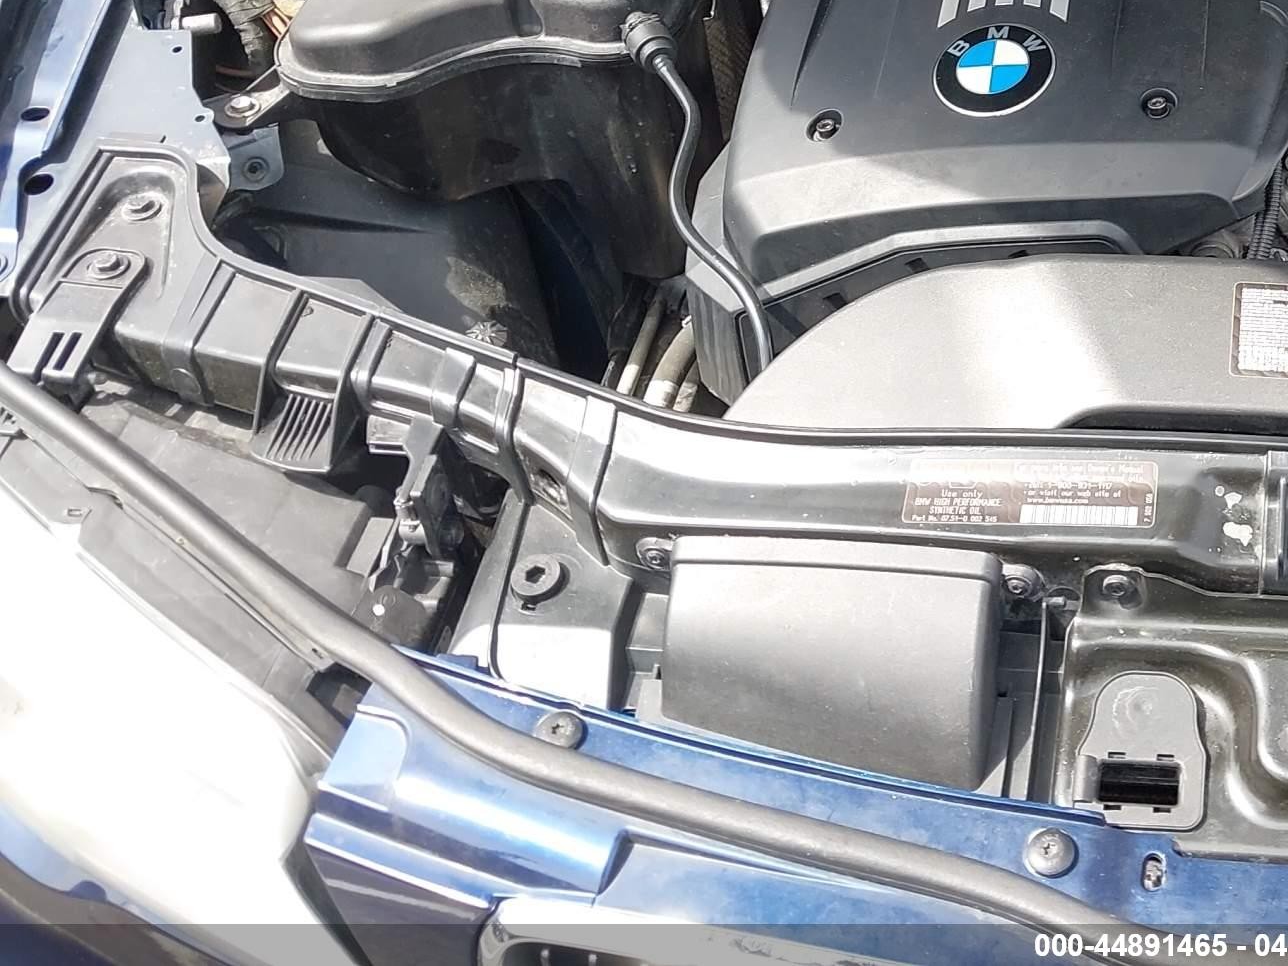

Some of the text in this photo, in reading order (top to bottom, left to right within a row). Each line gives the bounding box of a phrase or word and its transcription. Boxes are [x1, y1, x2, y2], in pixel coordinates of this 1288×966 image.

[947, 25, 1046, 58] BMW
[941, 489, 983, 498] Use only
[914, 497, 1003, 507] BMW HIGH PERFORMANCE
[929, 506, 982, 515] SYNTHETIC OIL
